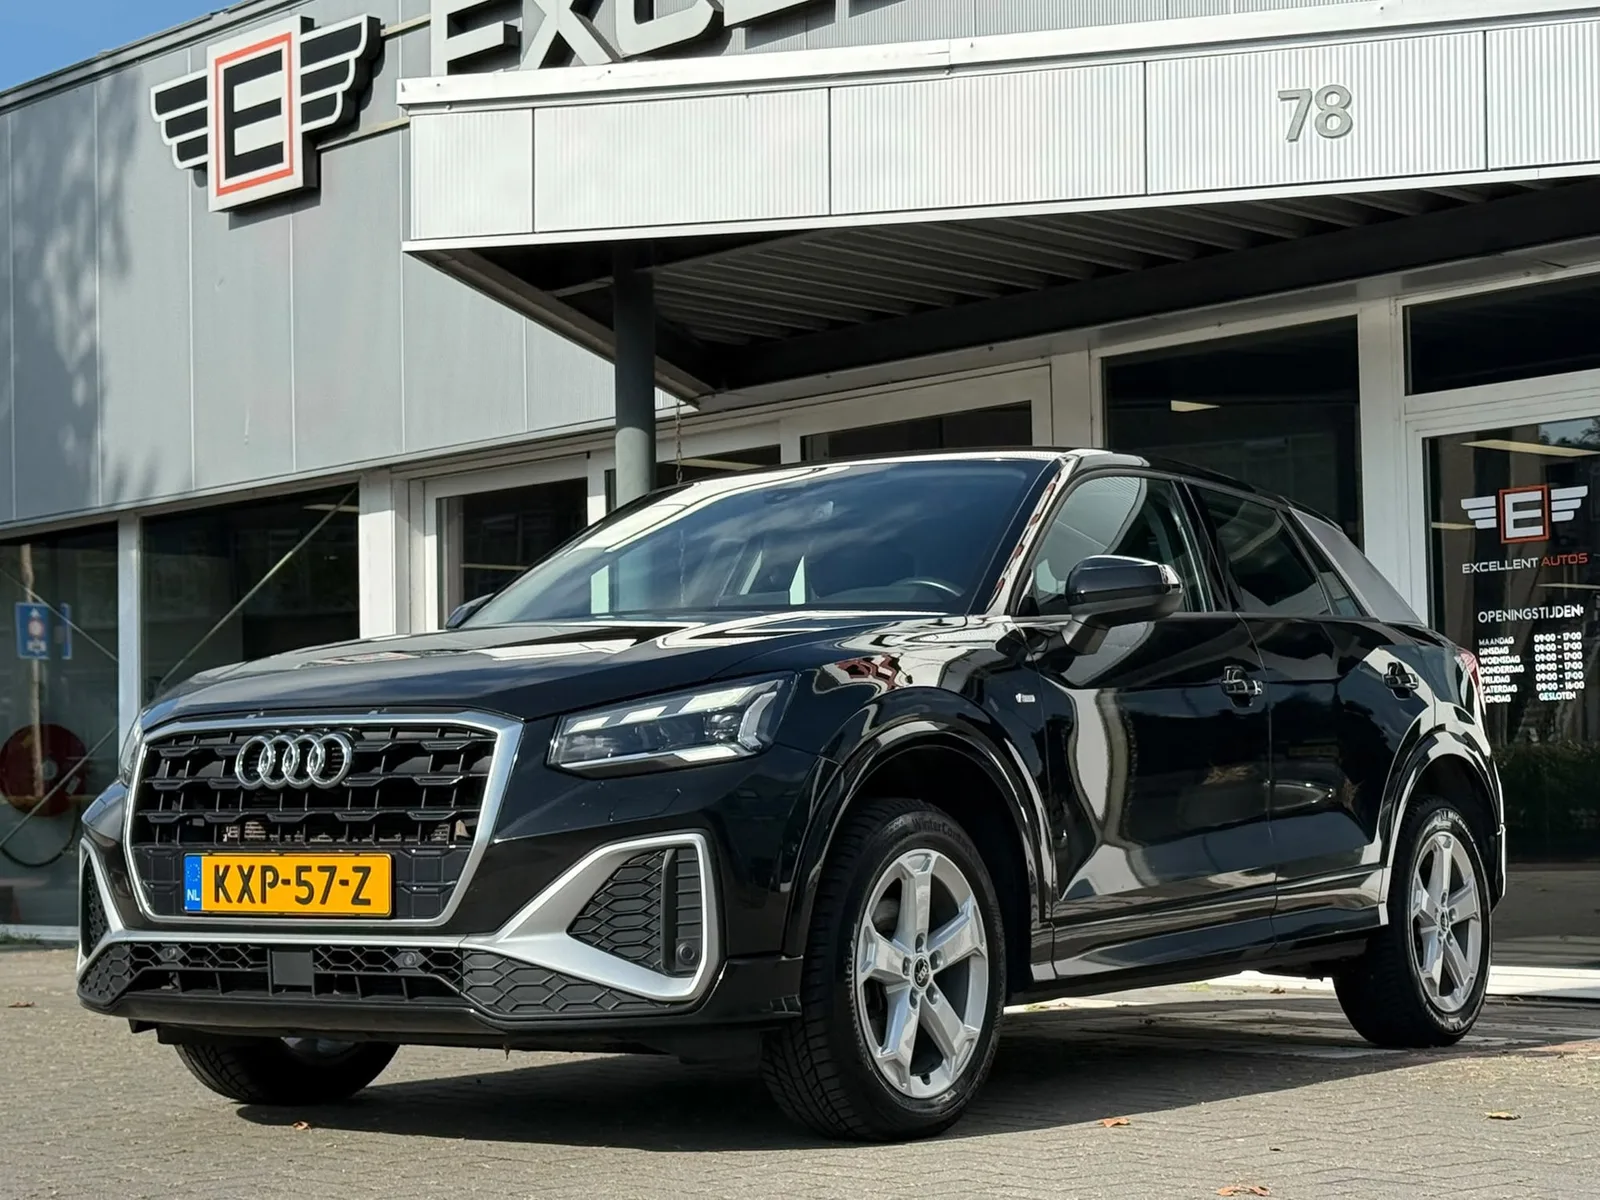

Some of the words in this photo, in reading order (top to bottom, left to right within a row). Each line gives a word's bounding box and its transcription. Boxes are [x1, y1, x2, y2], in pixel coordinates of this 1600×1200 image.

[224, 49, 284, 180] E
[1278, 84, 1353, 142] 78
[1504, 490, 1544, 538] E
[1462, 557, 1538, 574] EXCELLENT
[1541, 553, 1588, 567] AUTOS
[1478, 604, 1584, 623] OPENINGSTIJDEN:
[1478, 636, 1514, 646] MAANDAG
[1479, 646, 1509, 656] DINSDAG
[1480, 655, 1521, 665] WOENSDAG
[1480, 664, 1525, 675] DONDERDAG
[1484, 694, 1511, 704] ONDAG
[1539, 691, 1576, 701] GESLOTEN
[214, 864, 372, 906] KXP-57-Z
[187, 888, 200, 901] NL
